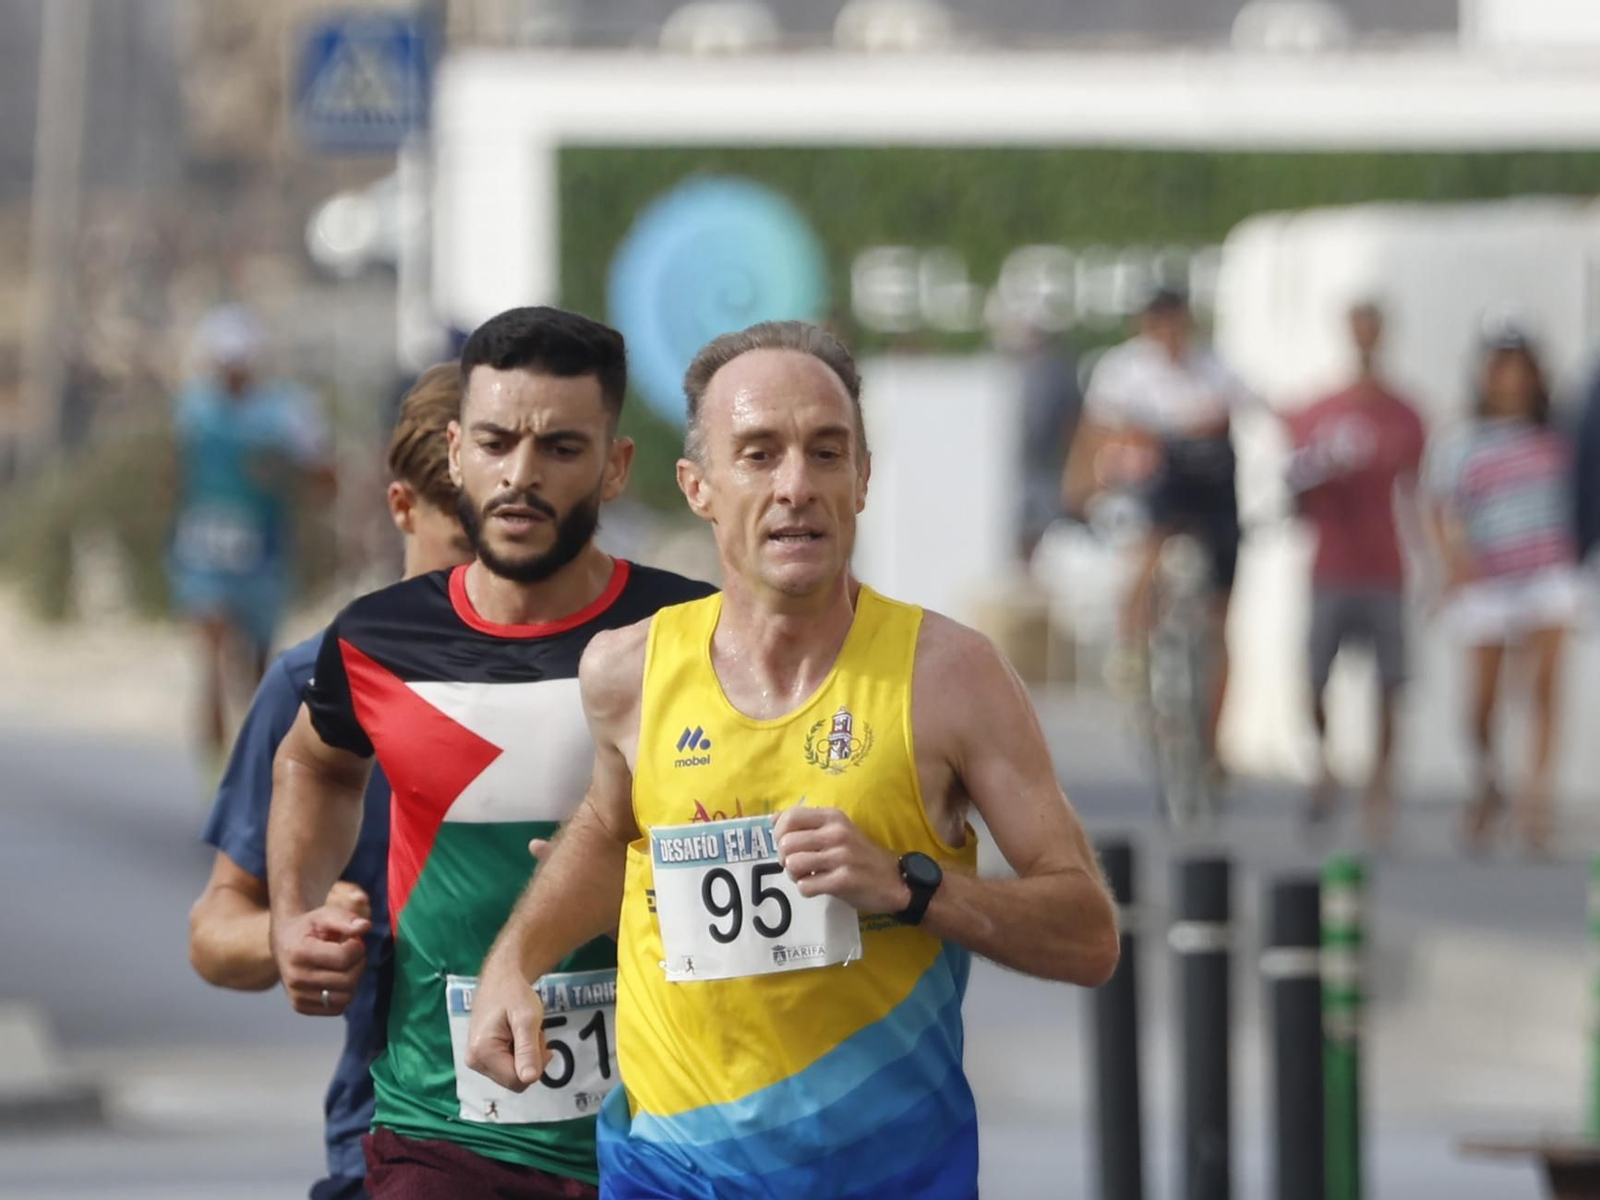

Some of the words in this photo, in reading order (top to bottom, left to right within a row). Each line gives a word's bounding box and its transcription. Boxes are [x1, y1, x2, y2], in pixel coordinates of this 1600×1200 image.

[675, 754, 710, 768] mobel
[723, 825, 769, 863] ELA
[701, 862, 792, 944] 95
[786, 946, 826, 958] TARIFA
[533, 982, 571, 1013] LA
[572, 981, 616, 1005] TARIF
